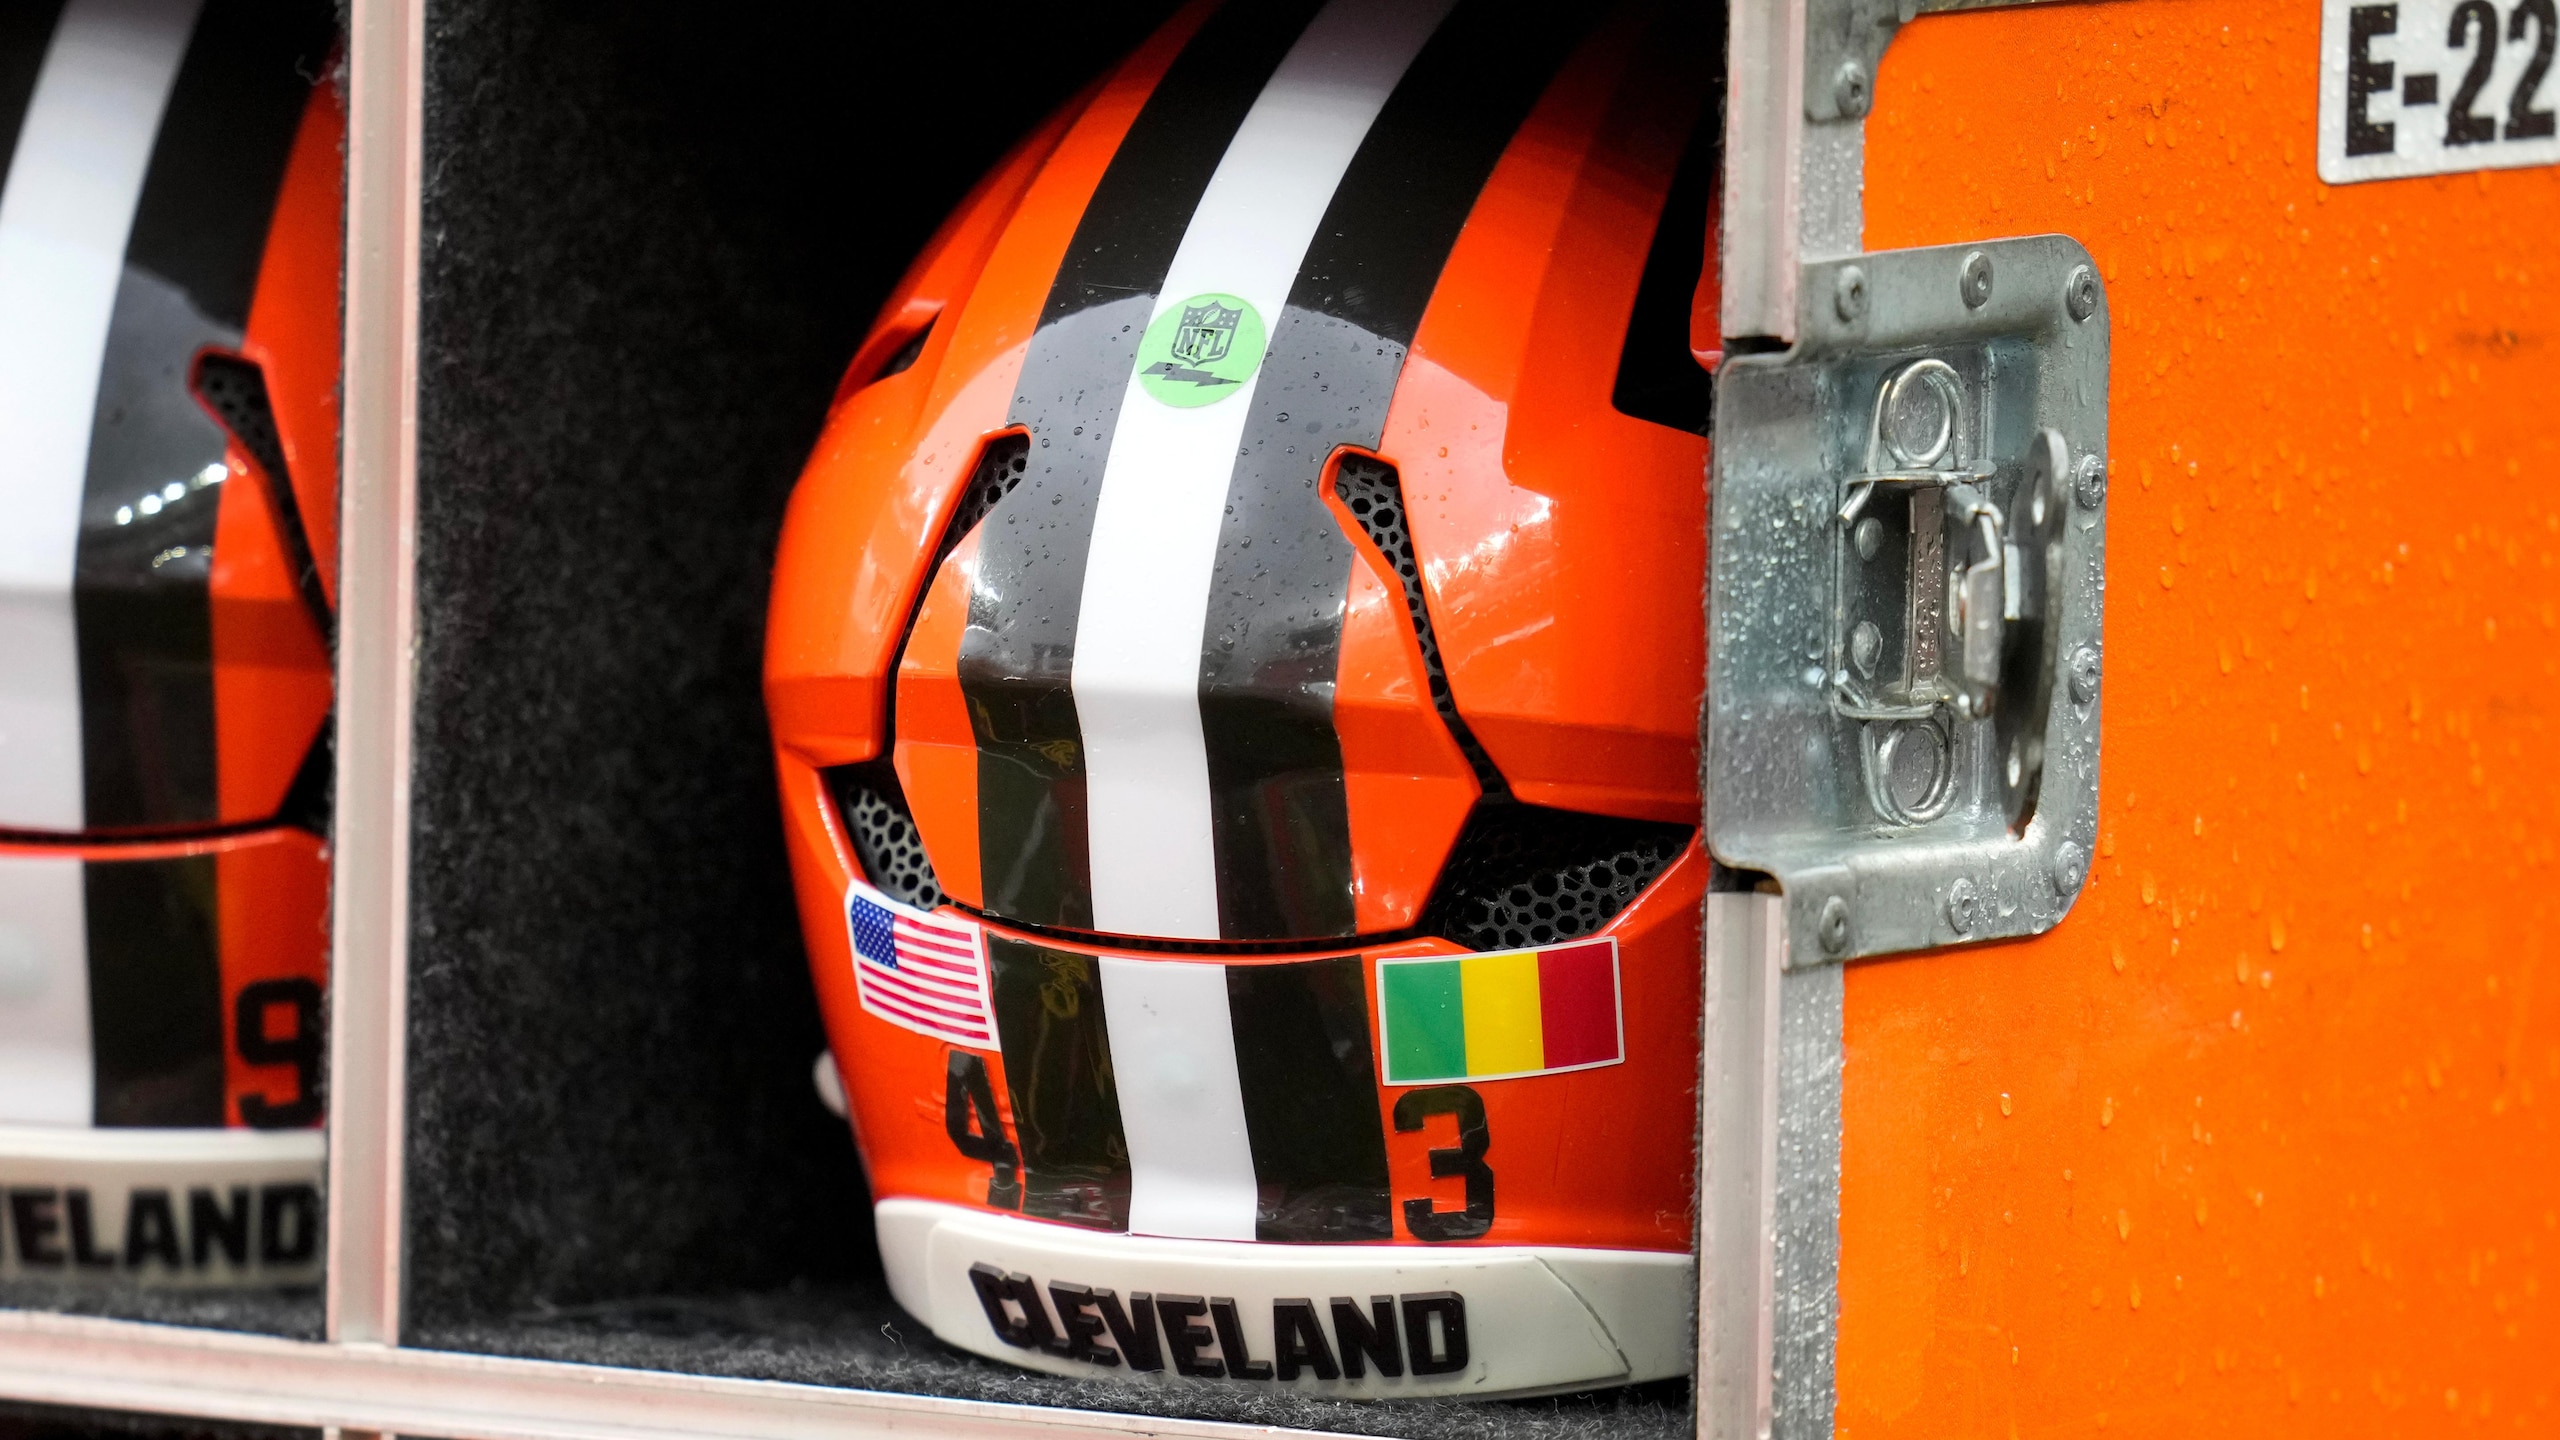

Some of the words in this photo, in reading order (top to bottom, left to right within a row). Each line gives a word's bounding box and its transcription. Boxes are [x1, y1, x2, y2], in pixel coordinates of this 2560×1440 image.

[2346, 0, 2556, 157] E-22
[1176, 327, 1224, 360] NFL
[237, 976, 325, 1130] 9
[945, 1049, 1023, 1211] 4
[1393, 1085, 1495, 1242] 3
[0, 1183, 322, 1269] ELAND
[968, 1261, 1470, 1381] CLEVELAND
